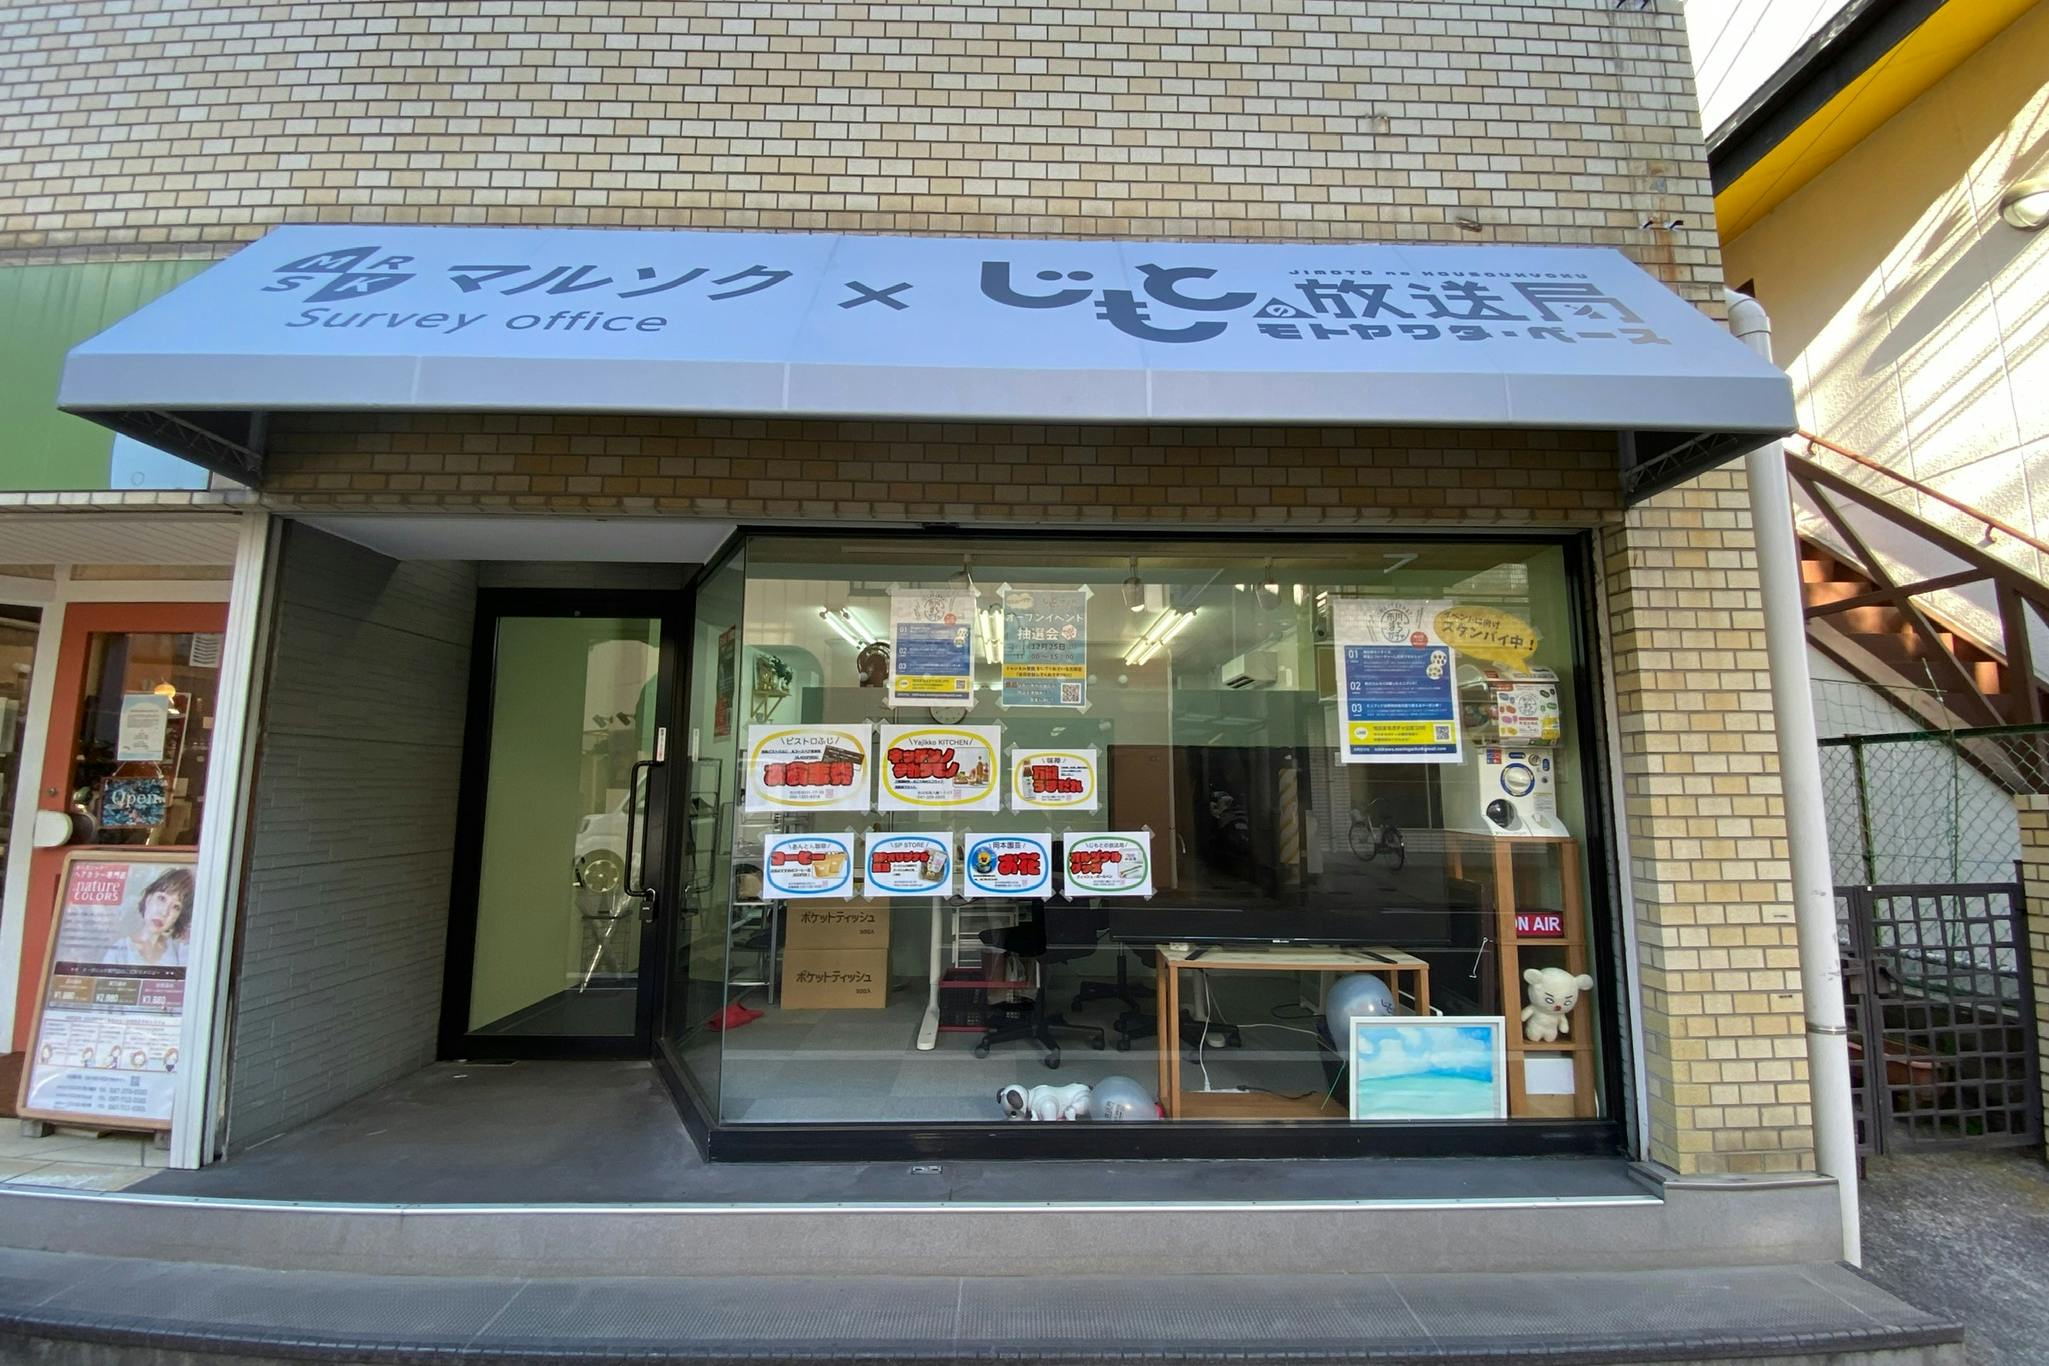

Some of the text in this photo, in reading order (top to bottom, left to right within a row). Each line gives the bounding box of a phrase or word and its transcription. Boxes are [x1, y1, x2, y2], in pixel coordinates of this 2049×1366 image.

[447, 264, 793, 300] マルソク
[285, 307, 668, 334] Survey office
[1017, 627, 1060, 640] 抽選会
[1348, 649, 1359, 659] 01
[1350, 681, 1361, 691] 02
[1351, 703, 1362, 713] 03
[786, 736, 834, 745] ビストロふじ
[938, 738, 969, 746] KITCHEN
[111, 789, 165, 807] Open
[771, 850, 826, 866] コーヒー
[998, 852, 1041, 875] お花
[75, 880, 121, 893] nature
[74, 891, 119, 902] COLORS
[801, 911, 876, 923] ポケットティッシュ
[1515, 916, 1561, 931] N AIR
[796, 970, 872, 983] ポケットティッシュ
